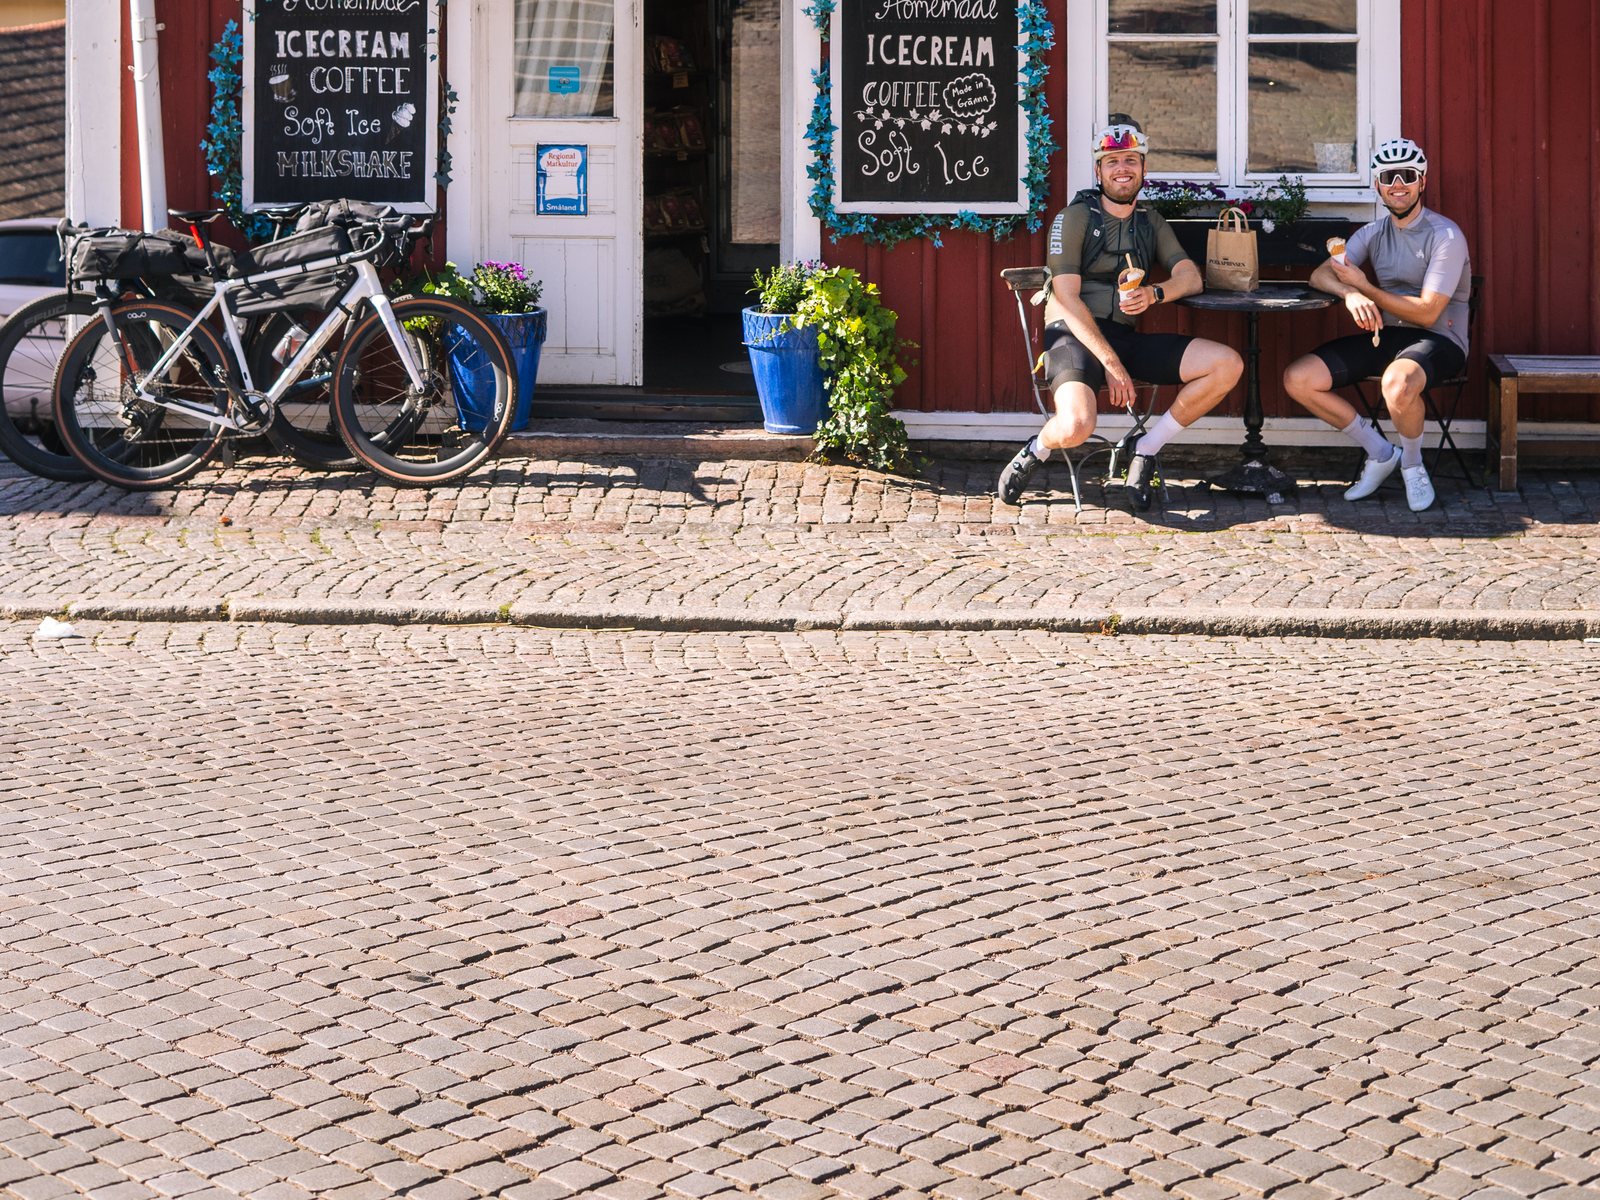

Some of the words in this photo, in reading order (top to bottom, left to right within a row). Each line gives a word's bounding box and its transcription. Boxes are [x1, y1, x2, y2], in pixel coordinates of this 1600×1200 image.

[275, 30, 410, 58] ICECREAM
[866, 34, 995, 67] ICECREAM
[309, 66, 410, 94] COFFEE
[862, 81, 941, 107] COFFEE
[952, 86, 972, 98] Made
[975, 81, 984, 89] in
[283, 106, 335, 144] Soft
[346, 109, 381, 137] Ice
[276, 150, 414, 179] MILKSHAKE
[546, 160, 578, 168] Matkultur
[548, 153, 576, 161] Regional
[858, 129, 920, 183] Soft
[934, 141, 990, 185] Ice
[546, 203, 577, 211] Småland
